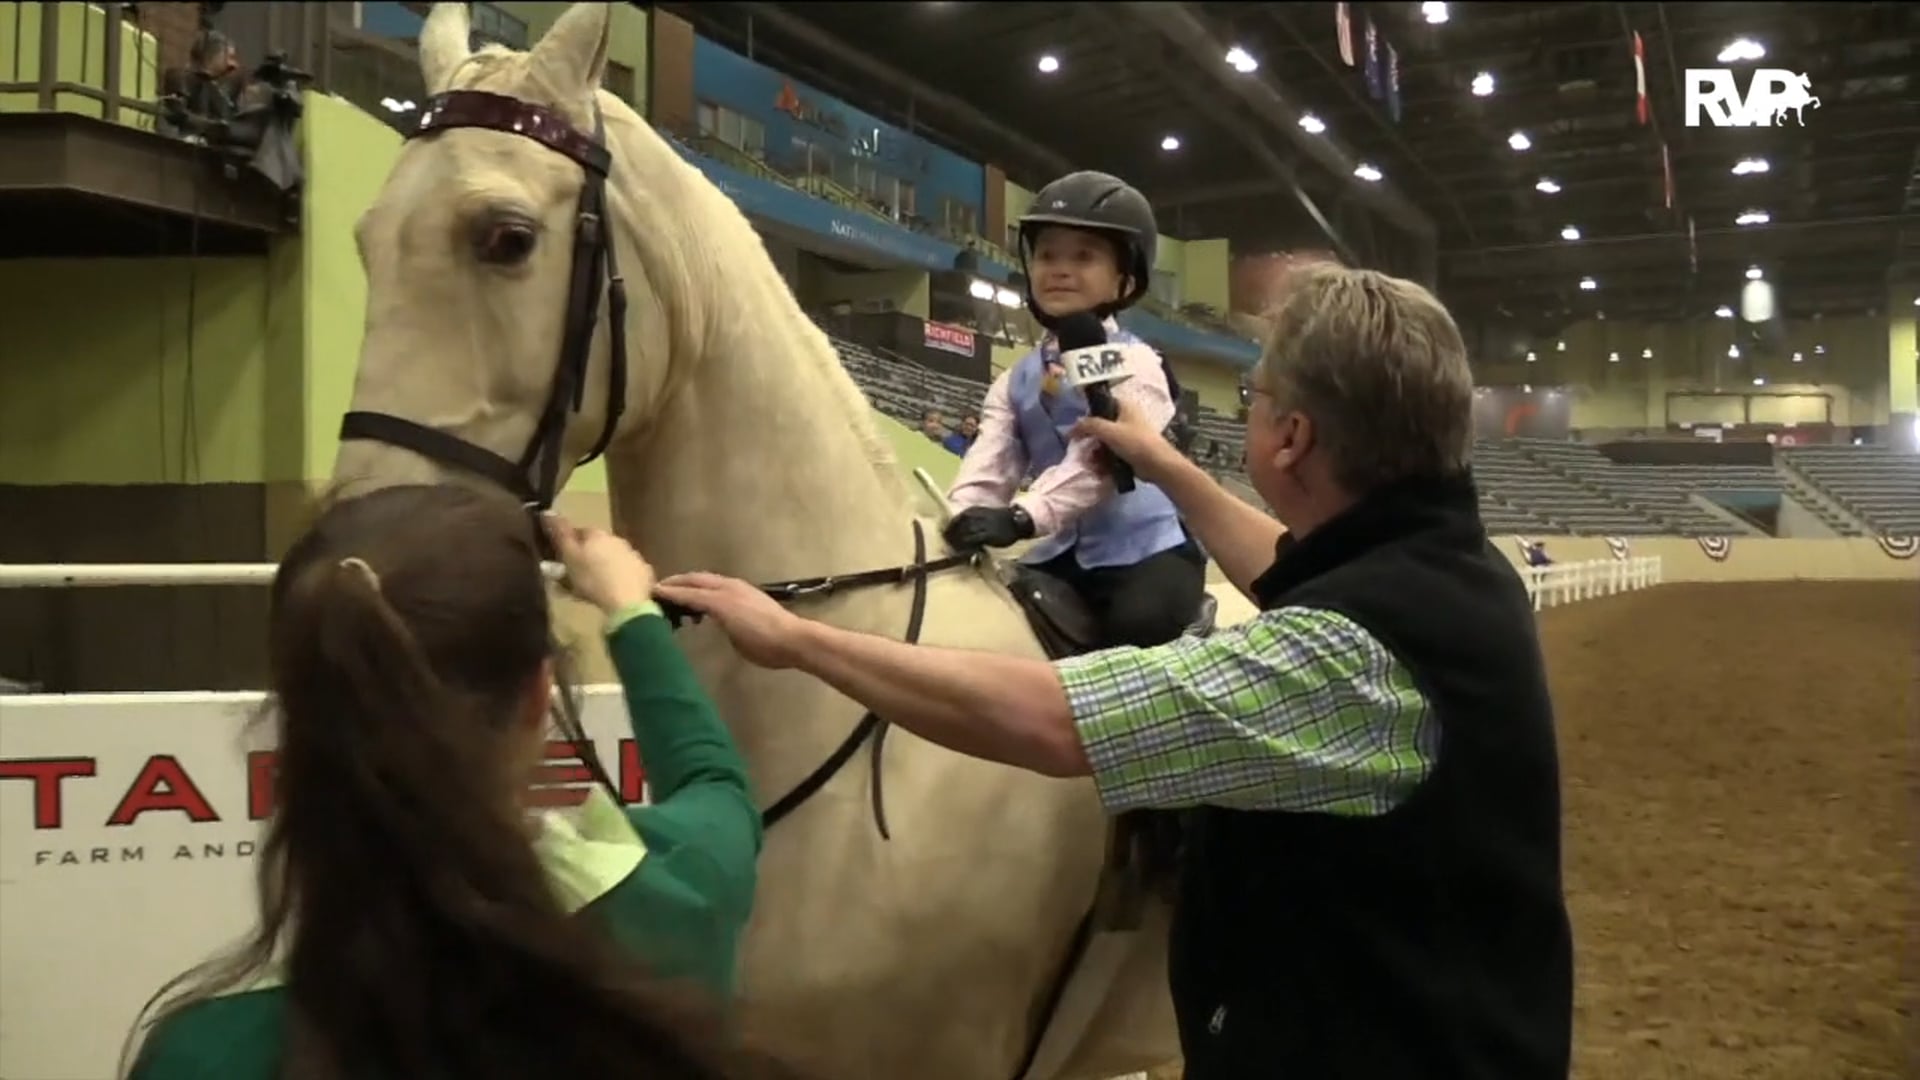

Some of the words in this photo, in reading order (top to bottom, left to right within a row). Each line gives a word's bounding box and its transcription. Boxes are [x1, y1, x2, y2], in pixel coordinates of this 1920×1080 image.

[1077, 350, 1124, 378] RVP
[34, 848, 144, 866] FARM
[174, 840, 256, 860] AND
